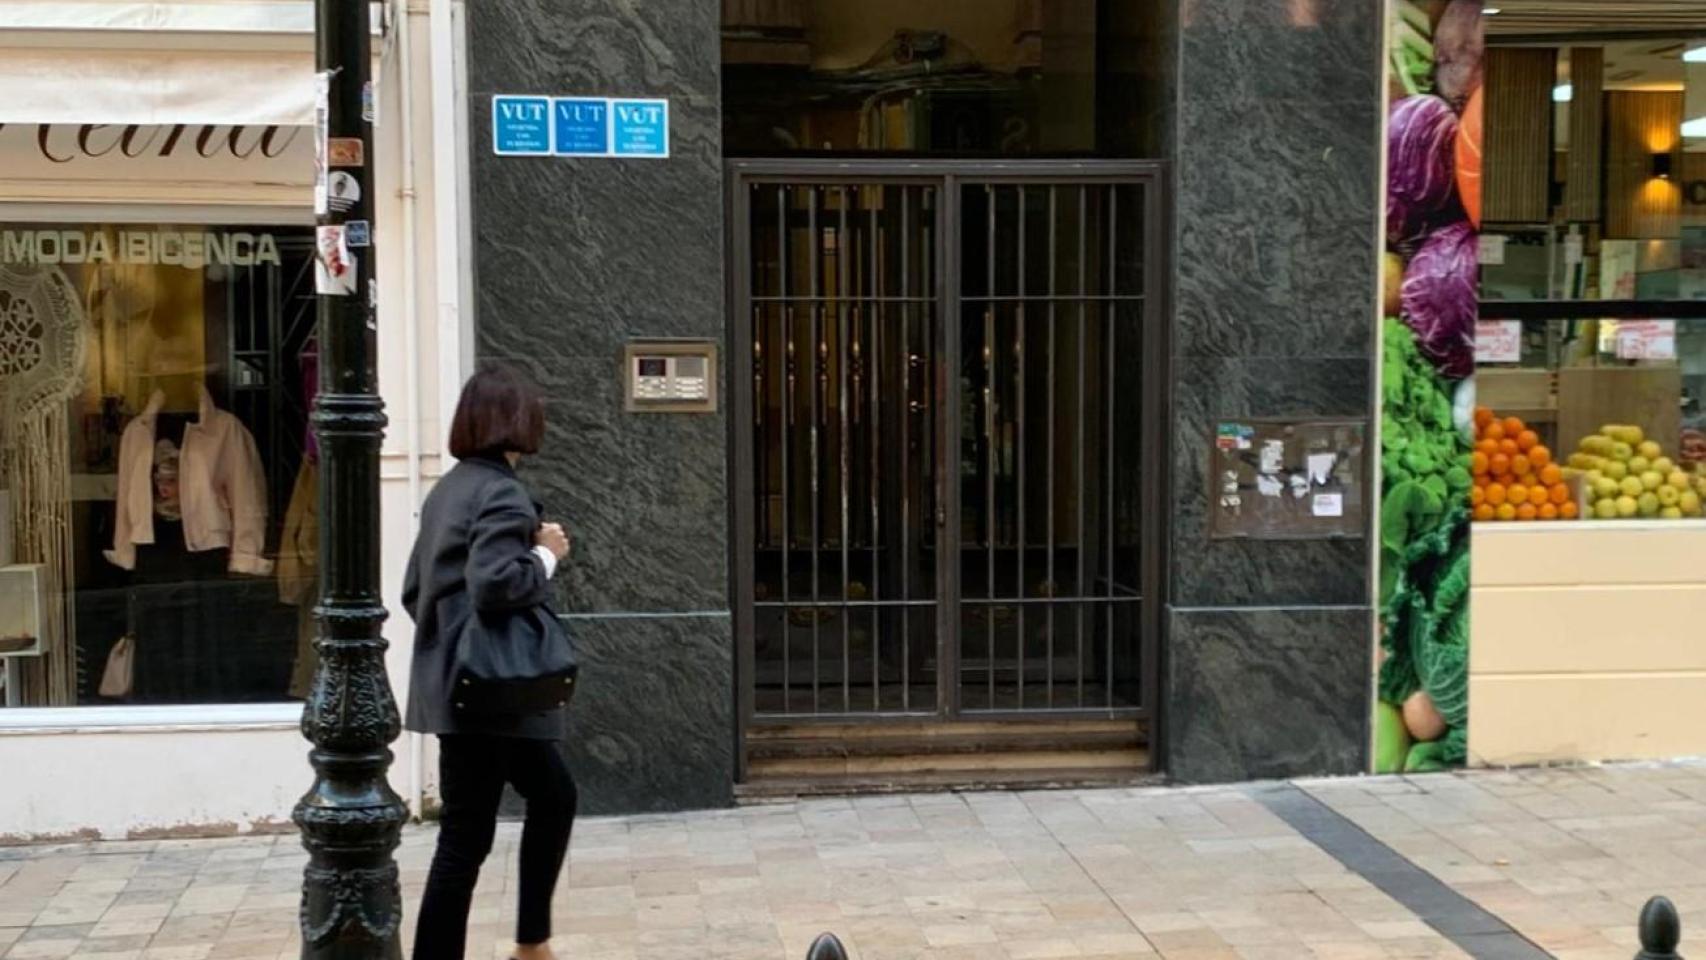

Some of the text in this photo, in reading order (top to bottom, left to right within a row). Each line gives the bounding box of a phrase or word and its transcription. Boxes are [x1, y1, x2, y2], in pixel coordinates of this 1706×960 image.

[501, 102, 545, 121] VUT
[559, 104, 604, 123] VUT
[617, 105, 661, 124] VUT
[3, 230, 281, 269] MODA IBICENCA
